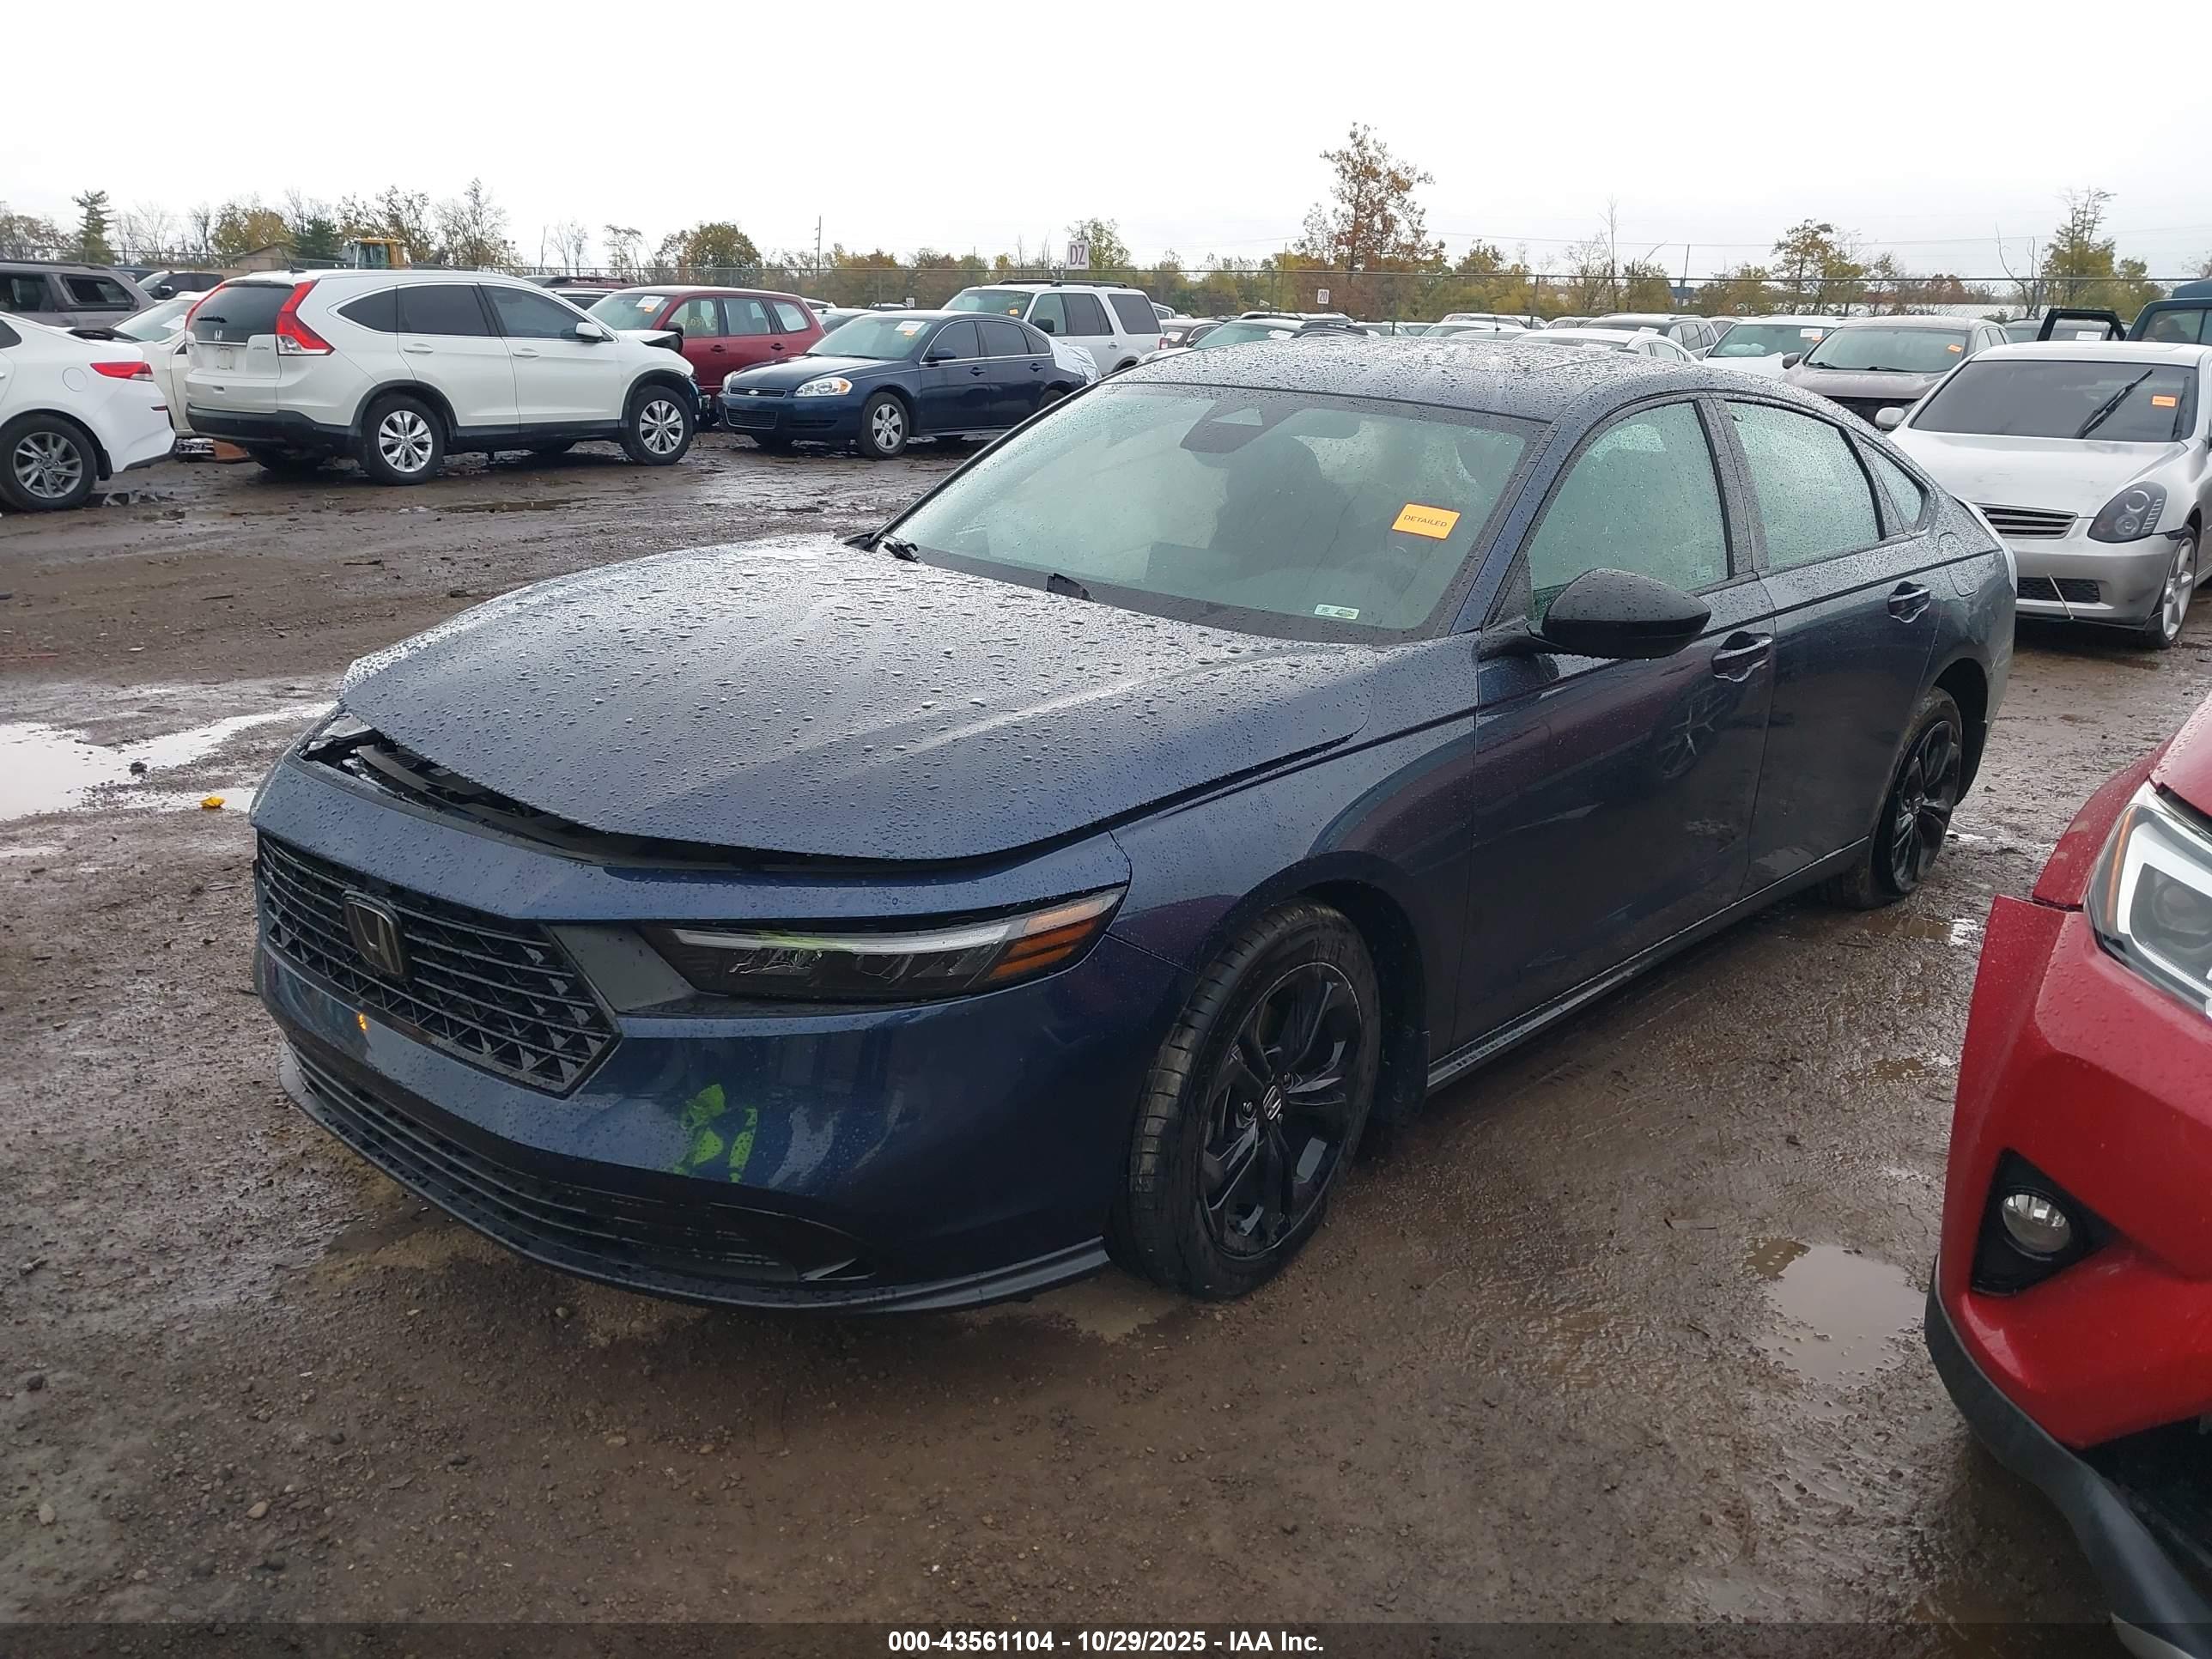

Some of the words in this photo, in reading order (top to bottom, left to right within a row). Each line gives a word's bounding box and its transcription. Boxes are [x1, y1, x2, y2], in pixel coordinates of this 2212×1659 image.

[1069, 244, 1086, 265] DZ
[1319, 290, 1328, 302] 20
[1403, 514, 1448, 528] DETAILED
